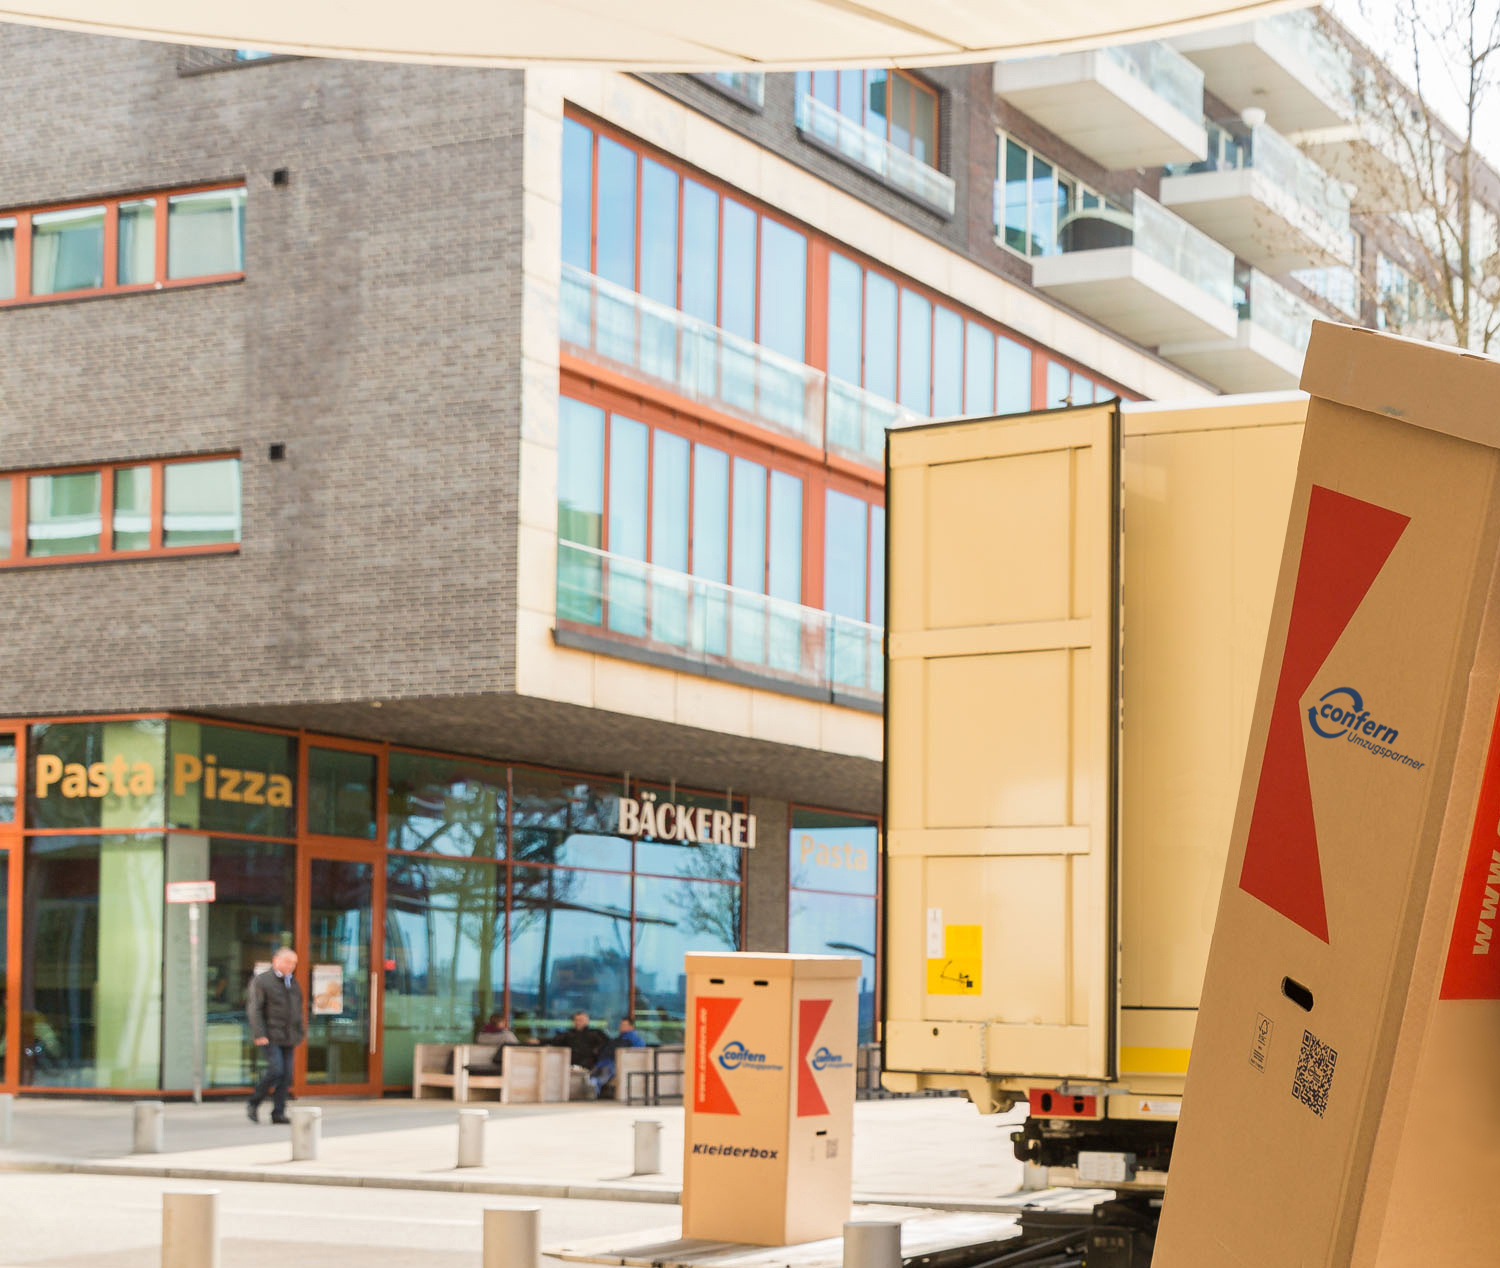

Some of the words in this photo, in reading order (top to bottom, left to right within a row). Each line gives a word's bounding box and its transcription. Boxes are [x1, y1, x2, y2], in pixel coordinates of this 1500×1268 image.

[1320, 703, 1399, 745] confern
[1346, 731, 1426, 770] Umzugspartner
[35, 753, 156, 799] Pasta
[173, 752, 293, 808] Pizza
[618, 791, 757, 849] BÄCKEREI
[800, 833, 868, 871] Pasta
[724, 1049, 766, 1063] confern
[692, 1143, 778, 1160] Kleiderbox
